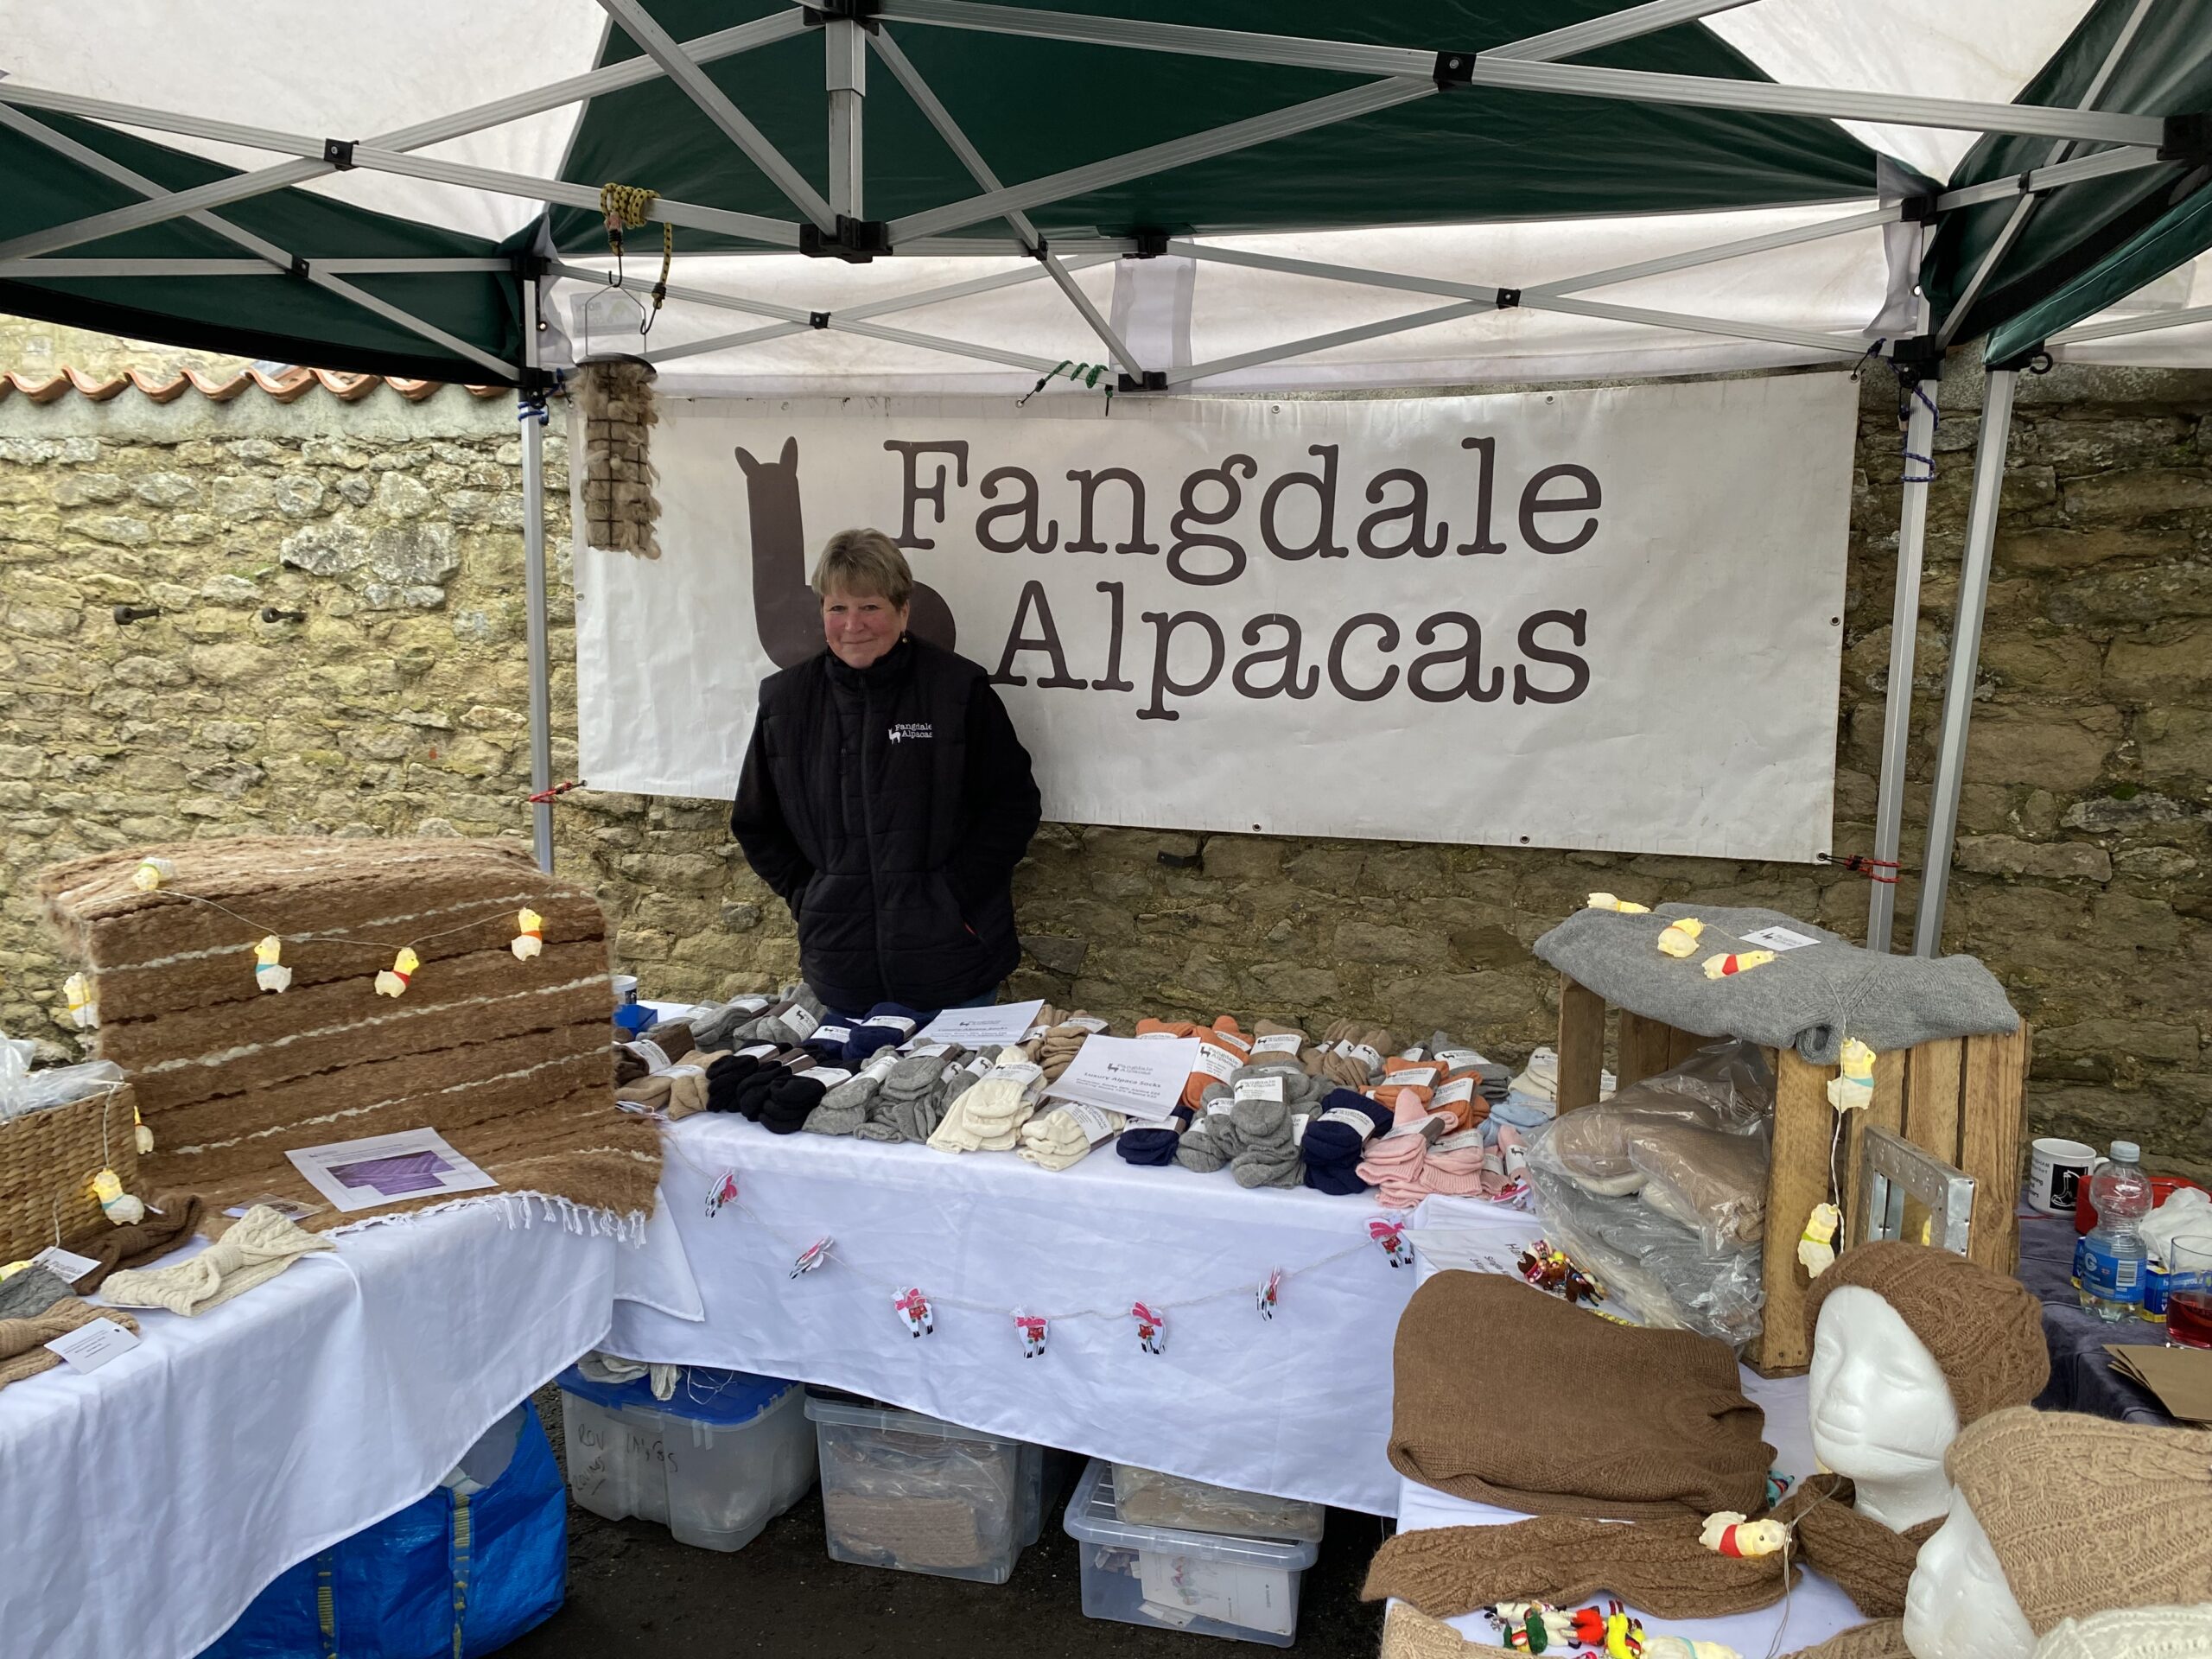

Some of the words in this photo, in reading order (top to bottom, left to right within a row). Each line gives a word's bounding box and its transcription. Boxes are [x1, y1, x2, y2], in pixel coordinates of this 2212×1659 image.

[883, 436, 1603, 586] Fangdale
[988, 580, 1591, 721] Alpacas
[894, 722, 932, 732] Fangdale
[901, 729, 933, 739] Alpacas
